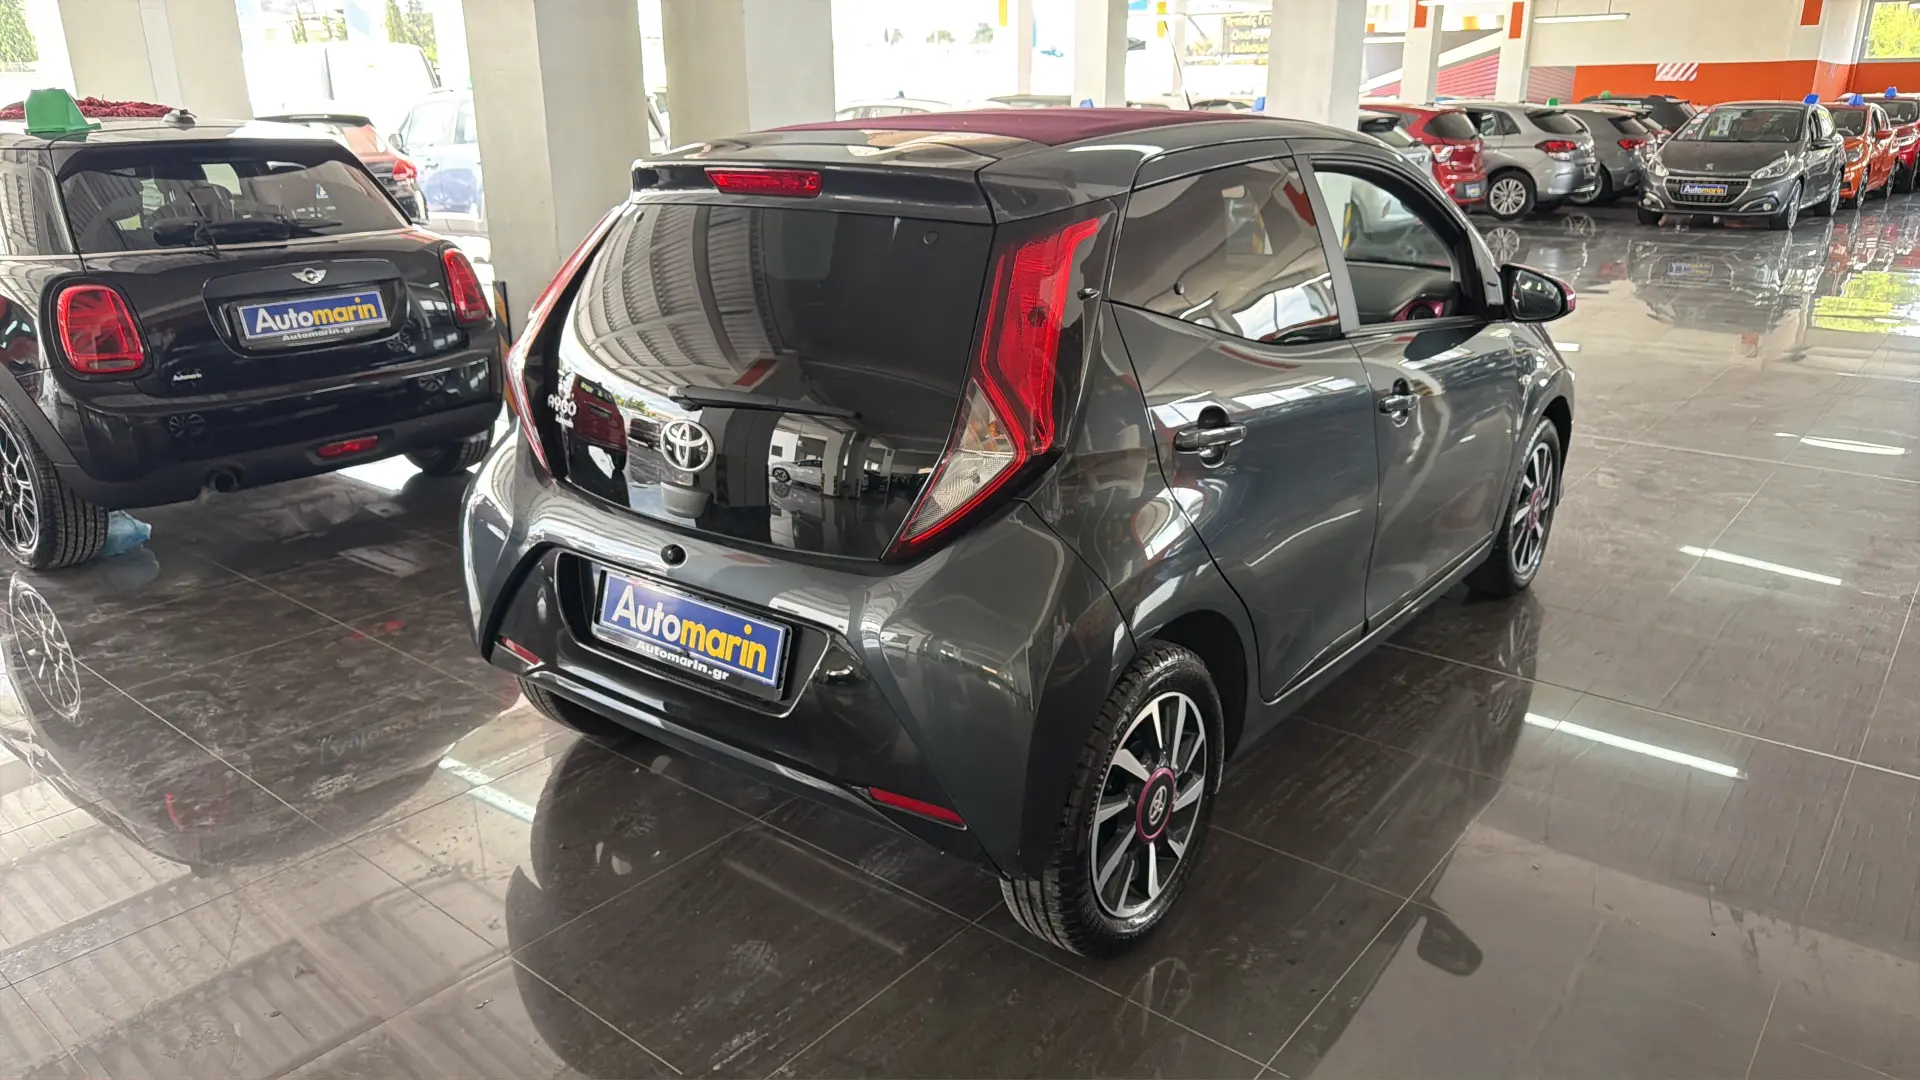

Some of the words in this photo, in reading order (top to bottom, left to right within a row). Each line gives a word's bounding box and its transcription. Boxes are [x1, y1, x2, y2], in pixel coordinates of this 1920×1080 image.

[1683, 184, 1724, 194] Automarin
[255, 297, 377, 333] Automarin
[282, 326, 356, 341] Automarin.gr
[547, 393, 577, 417] AYGO
[611, 584, 768, 673] Automarin
[636, 640, 730, 681] Automarin.gr
